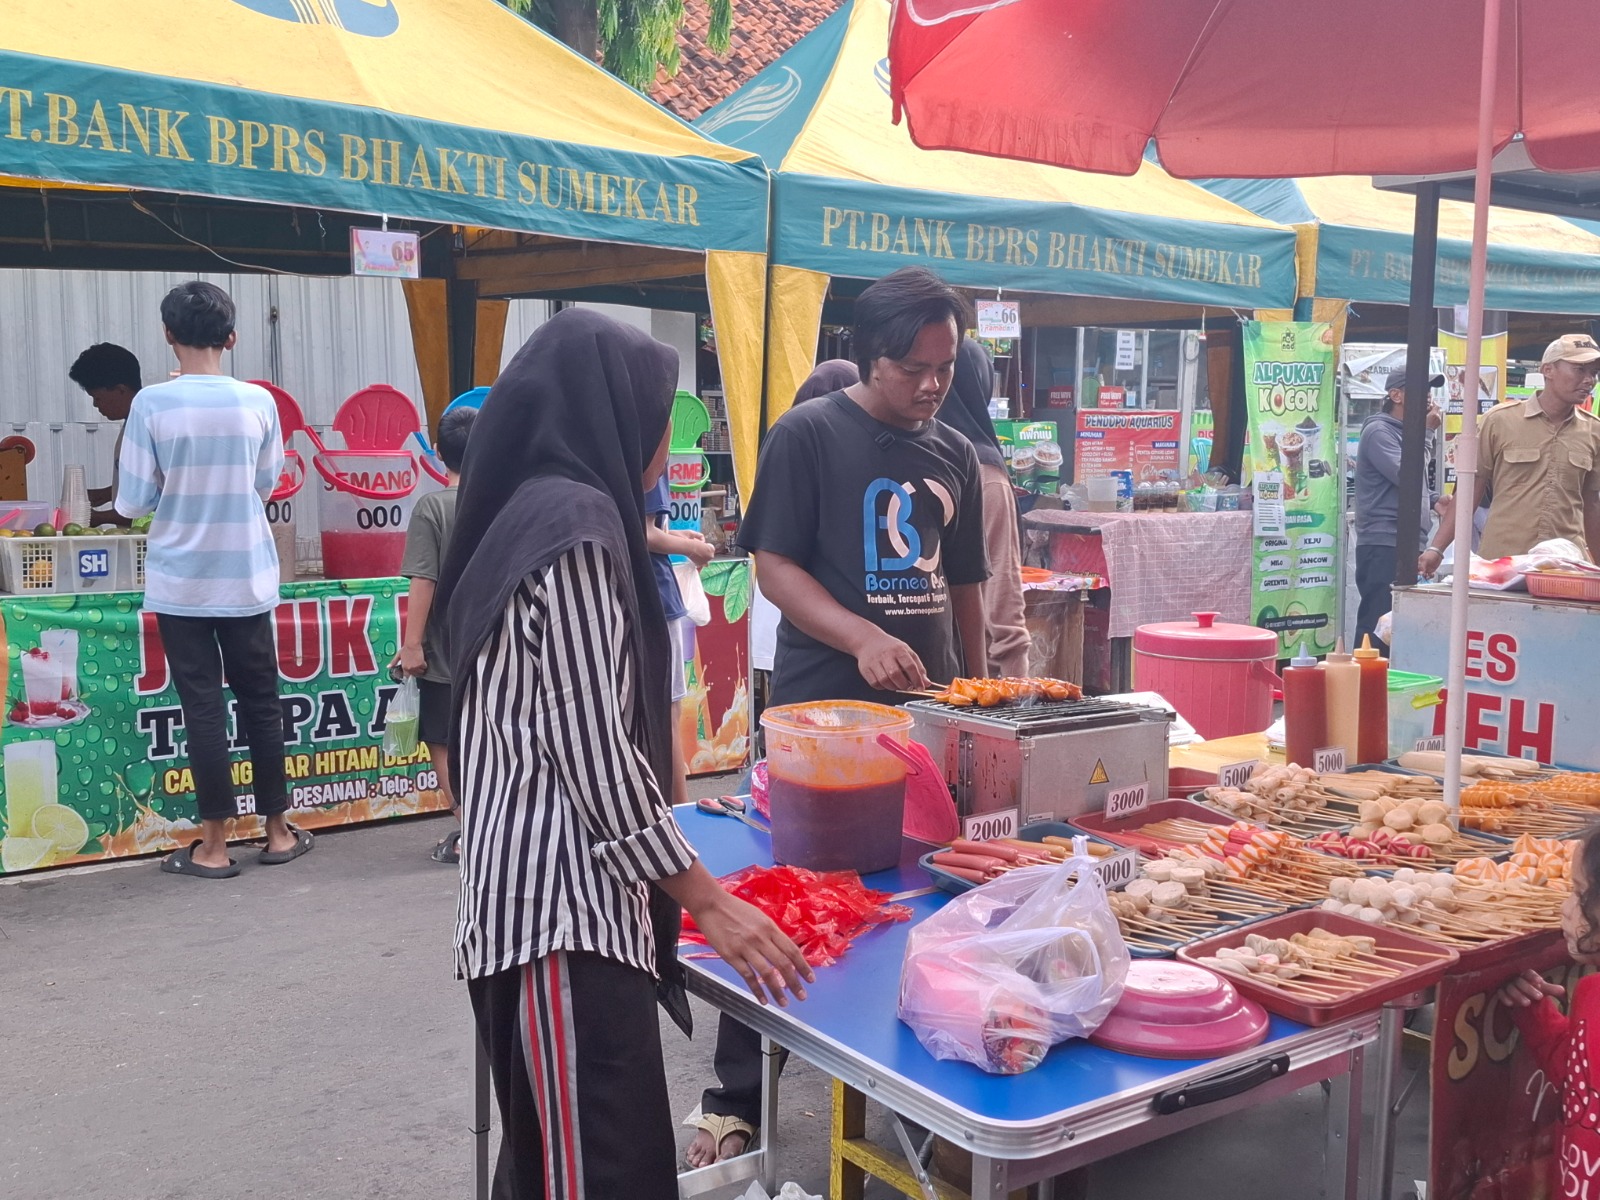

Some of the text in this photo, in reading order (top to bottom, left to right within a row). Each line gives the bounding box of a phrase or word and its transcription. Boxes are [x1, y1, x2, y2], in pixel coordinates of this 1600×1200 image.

[206, 115, 327, 177] BPRS
[339, 133, 508, 201] BHAKTI
[518, 160, 700, 227] SUMEKAR
[391, 240, 415, 262] 65
[821, 206, 1262, 289] PT.BANK BPRS BHAKTI SUMEKAR
[1384, 252, 1412, 281] BA
[1001, 308, 1017, 324] 66
[1253, 361, 1325, 386] ALPUKAT
[1258, 383, 1321, 416] KOCOK
[1085, 414, 1174, 430] PENDOPO AQUARIUS
[357, 504, 402, 530] 000
[80, 552, 108, 575] SH
[865, 573, 929, 591] Borneo
[866, 593, 897, 604] Terbaik,
[136, 593, 379, 693] JUK
[1464, 630, 1518, 683] ES
[140, 691, 358, 758] TPA
[164, 760, 254, 795] CANG
[315, 745, 378, 776] HITAM
[1318, 752, 1343, 773] 5000
[1223, 764, 1255, 788] 5000
[292, 780, 367, 808] PESANAN
[379, 774, 413, 797] Telp:
[1111, 787, 1145, 813] 3000
[971, 816, 1012, 842] 2000
